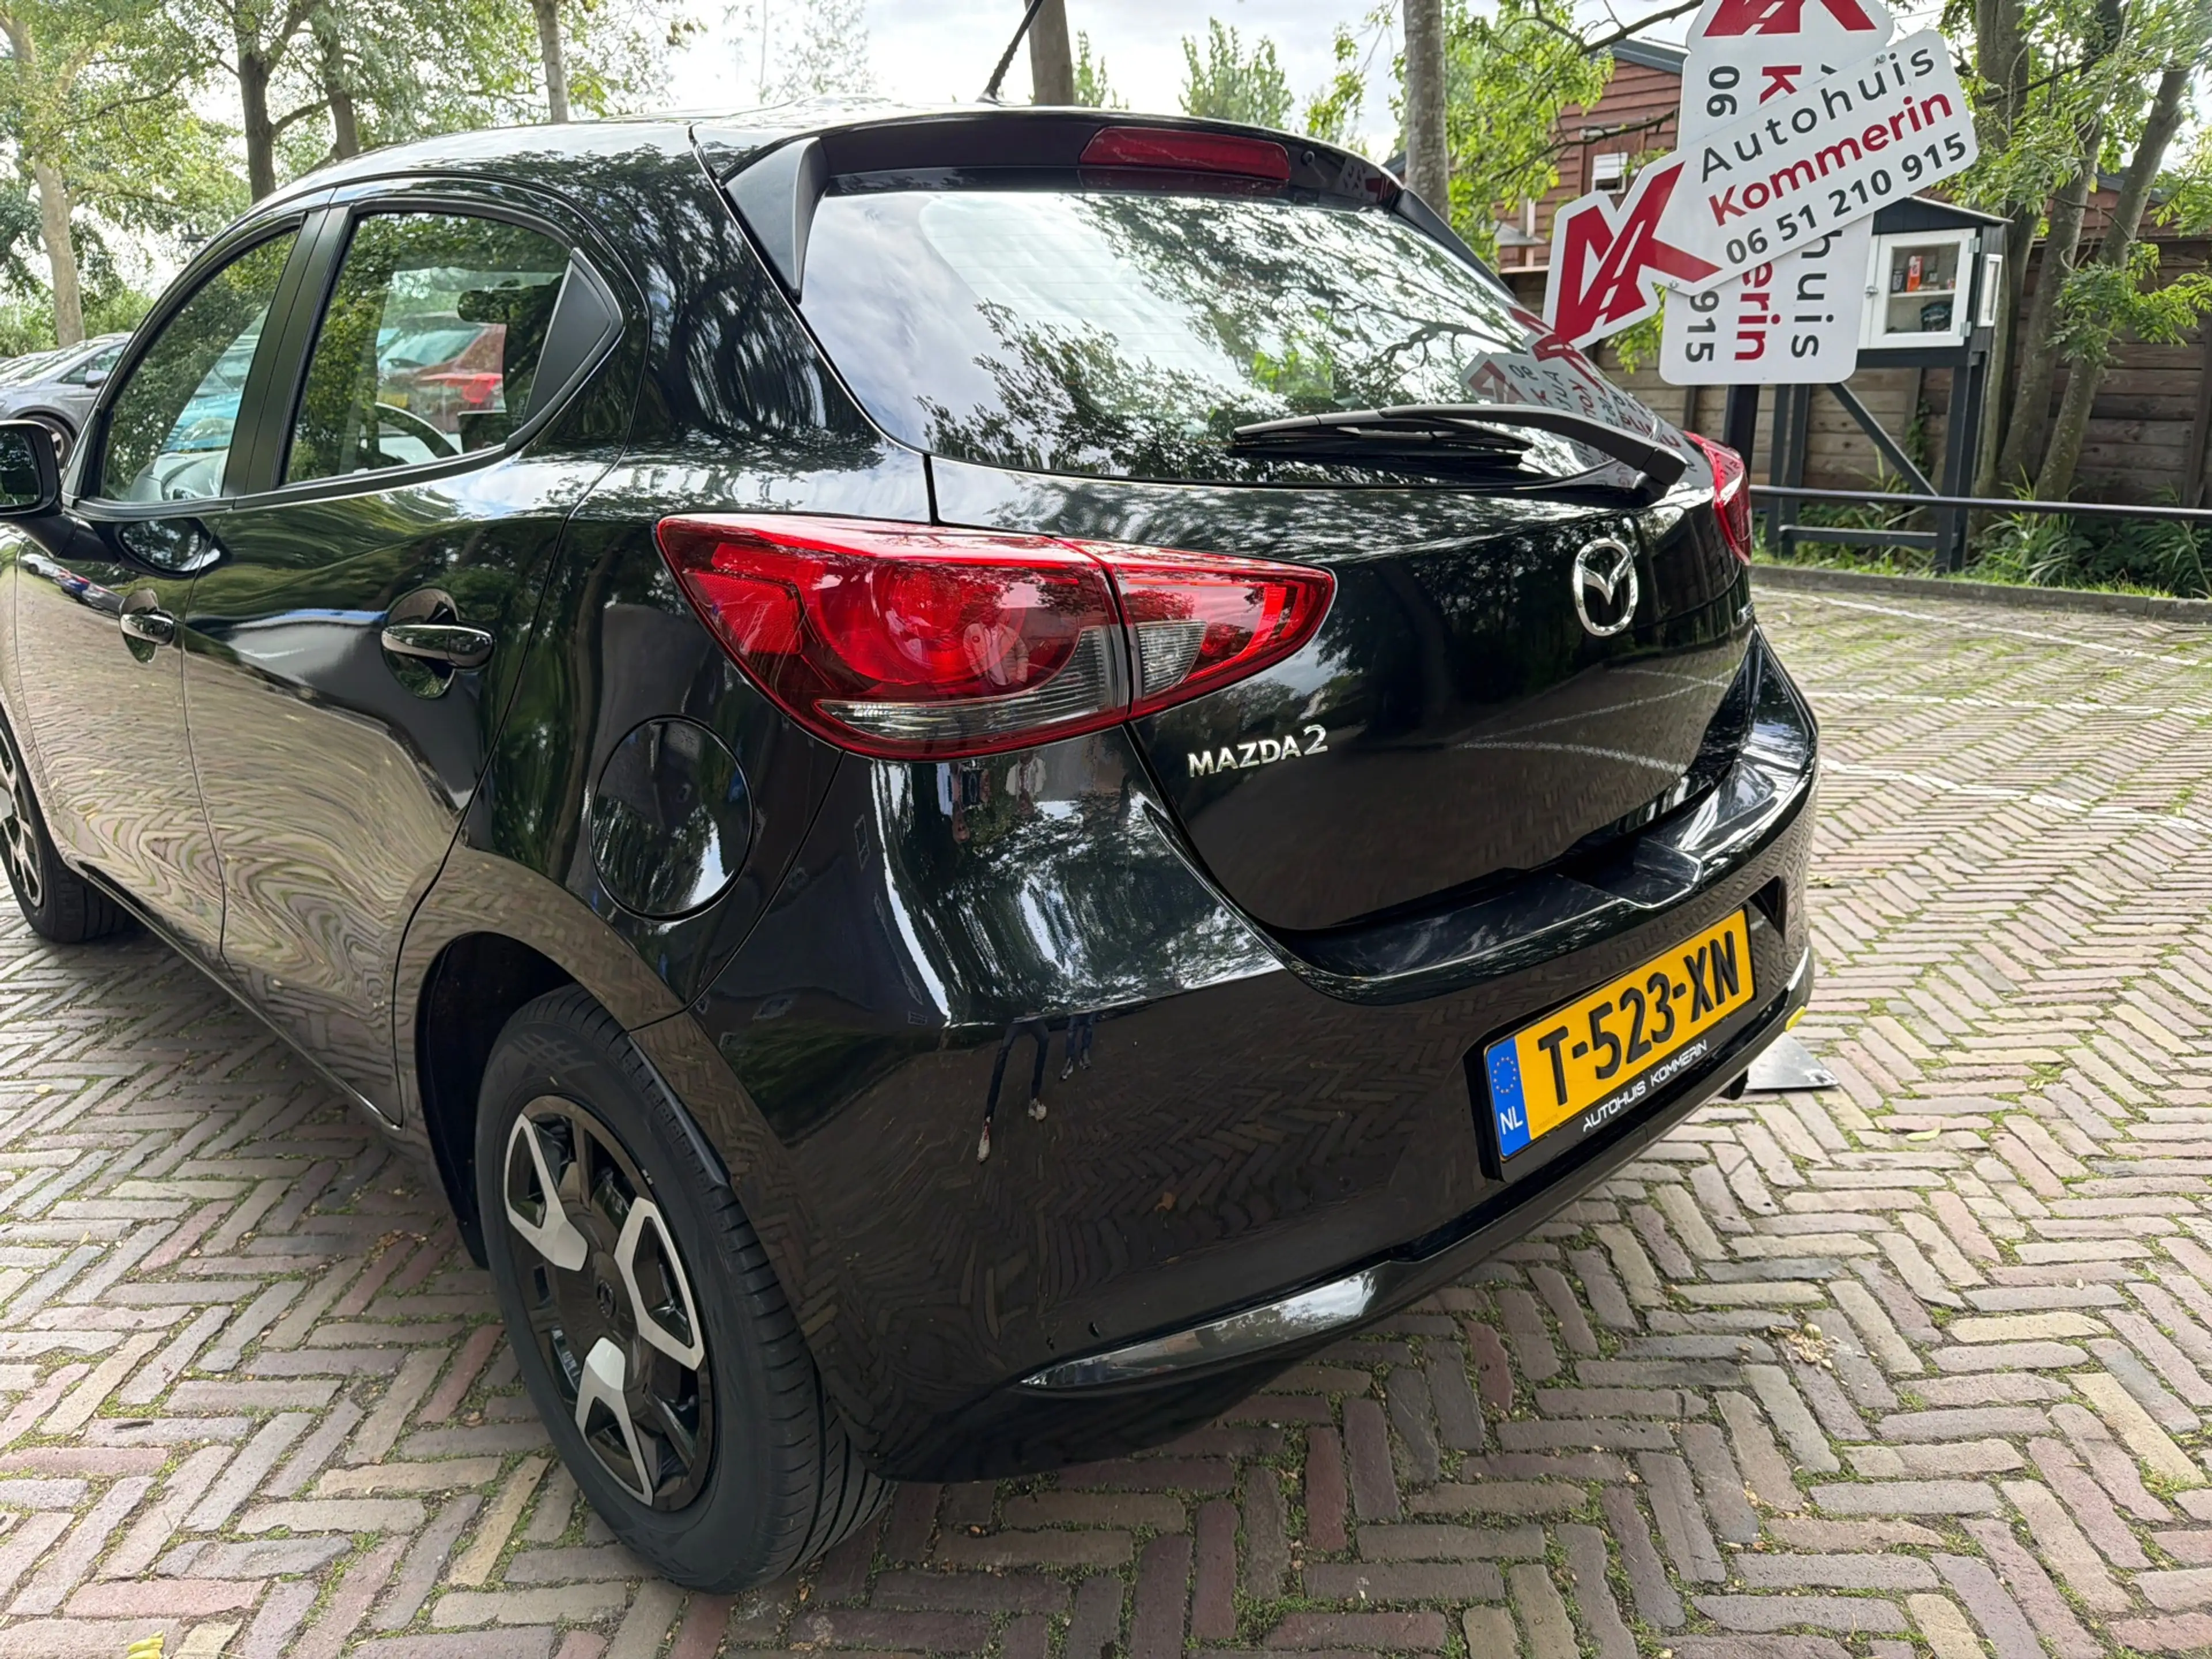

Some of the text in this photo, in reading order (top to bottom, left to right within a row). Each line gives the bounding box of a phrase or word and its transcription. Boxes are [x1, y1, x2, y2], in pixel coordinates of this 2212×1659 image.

[1700, 48, 1934, 183] Autohuis
[1706, 66, 1740, 118] 06
[1759, 65, 1802, 105] K
[1708, 93, 1953, 227] Kommerin
[1726, 132, 1966, 265] 06 51 210 915
[1537, 930, 1740, 1107] T-523-XN
[1499, 1105, 1524, 1135] NL
[1582, 1080, 1646, 1132] AUTOHUIS
[1650, 1039, 1707, 1087] KOMMERIN
